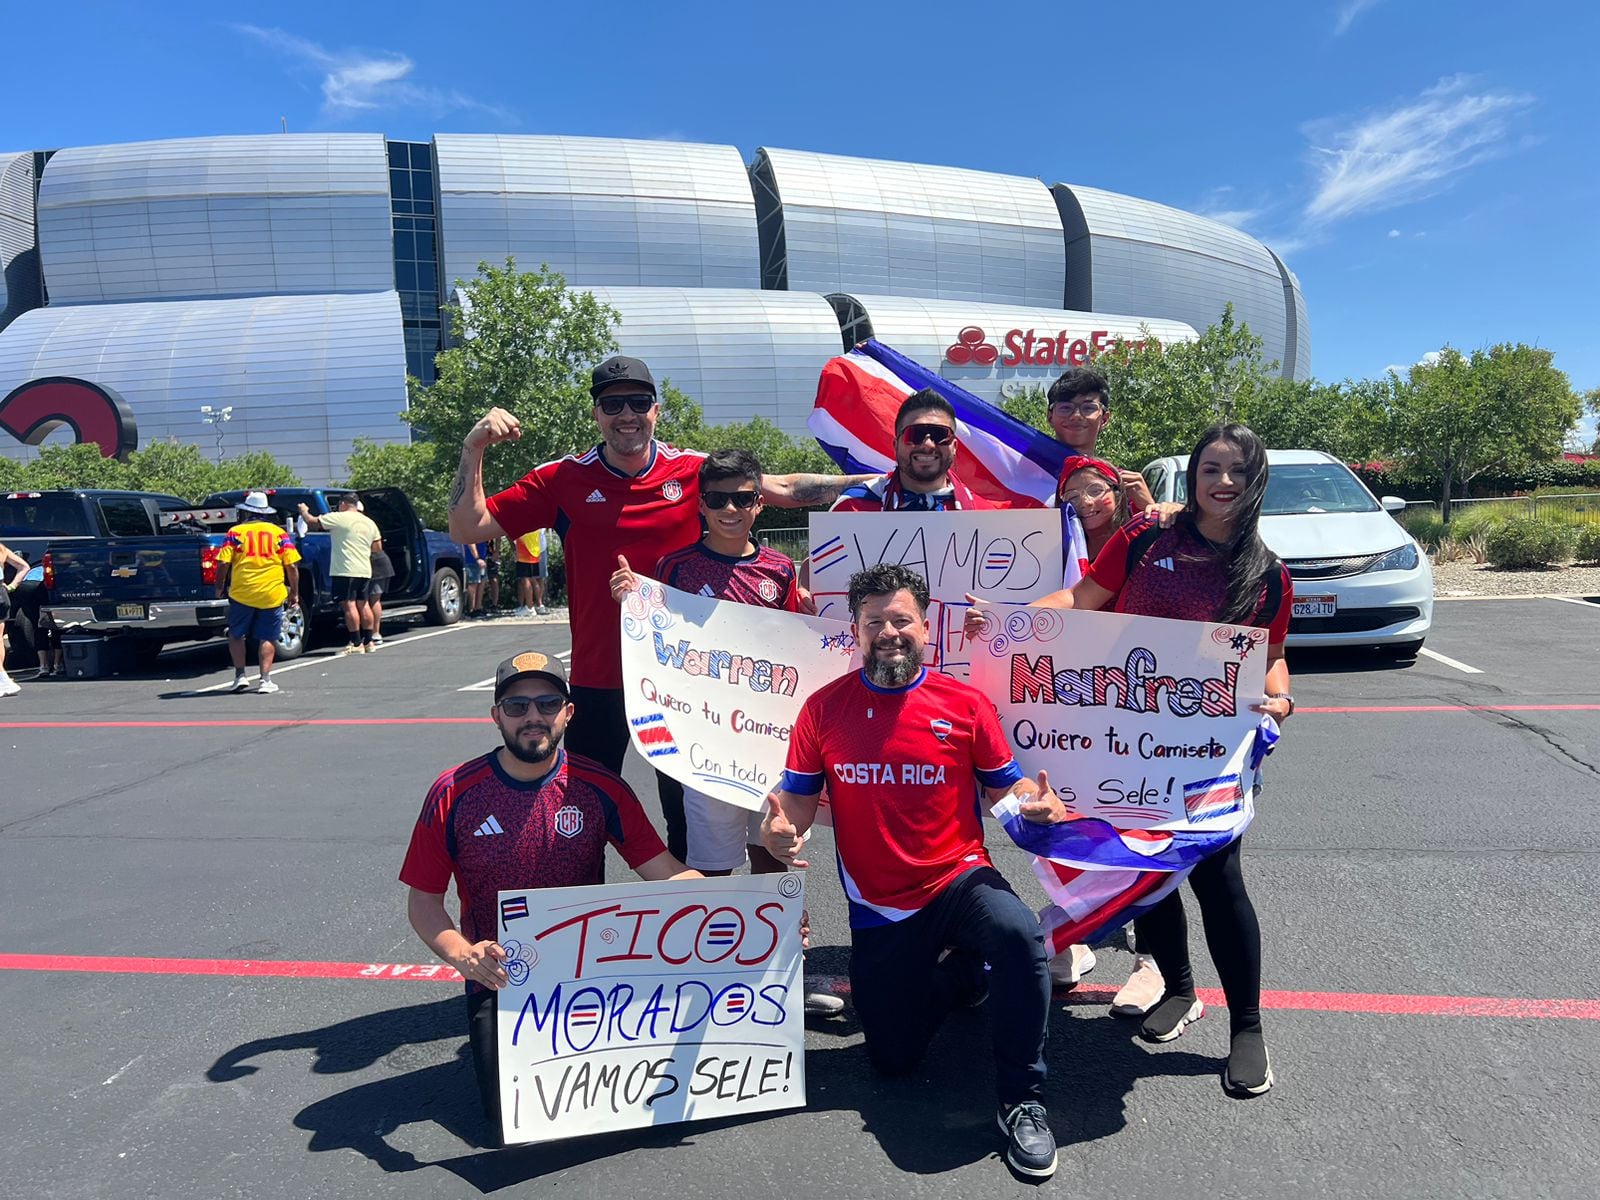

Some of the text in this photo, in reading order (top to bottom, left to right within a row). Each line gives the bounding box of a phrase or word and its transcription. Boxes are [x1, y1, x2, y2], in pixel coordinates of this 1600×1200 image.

[246, 530, 273, 558] 10
[653, 631, 799, 697] Warren
[1010, 647, 1241, 718] Manfred
[640, 677, 794, 742] Quiero tu Camise
[689, 742, 767, 785] Con toda
[1013, 719, 1092, 750] Quiero
[1104, 726, 1130, 756] tu
[833, 763, 946, 785] COSTA RICA
[1097, 776, 1176, 807] Sele!
[535, 902, 784, 979] TICOS
[512, 980, 788, 1056] MORADOS
[690, 1051, 793, 1103] SELE!
